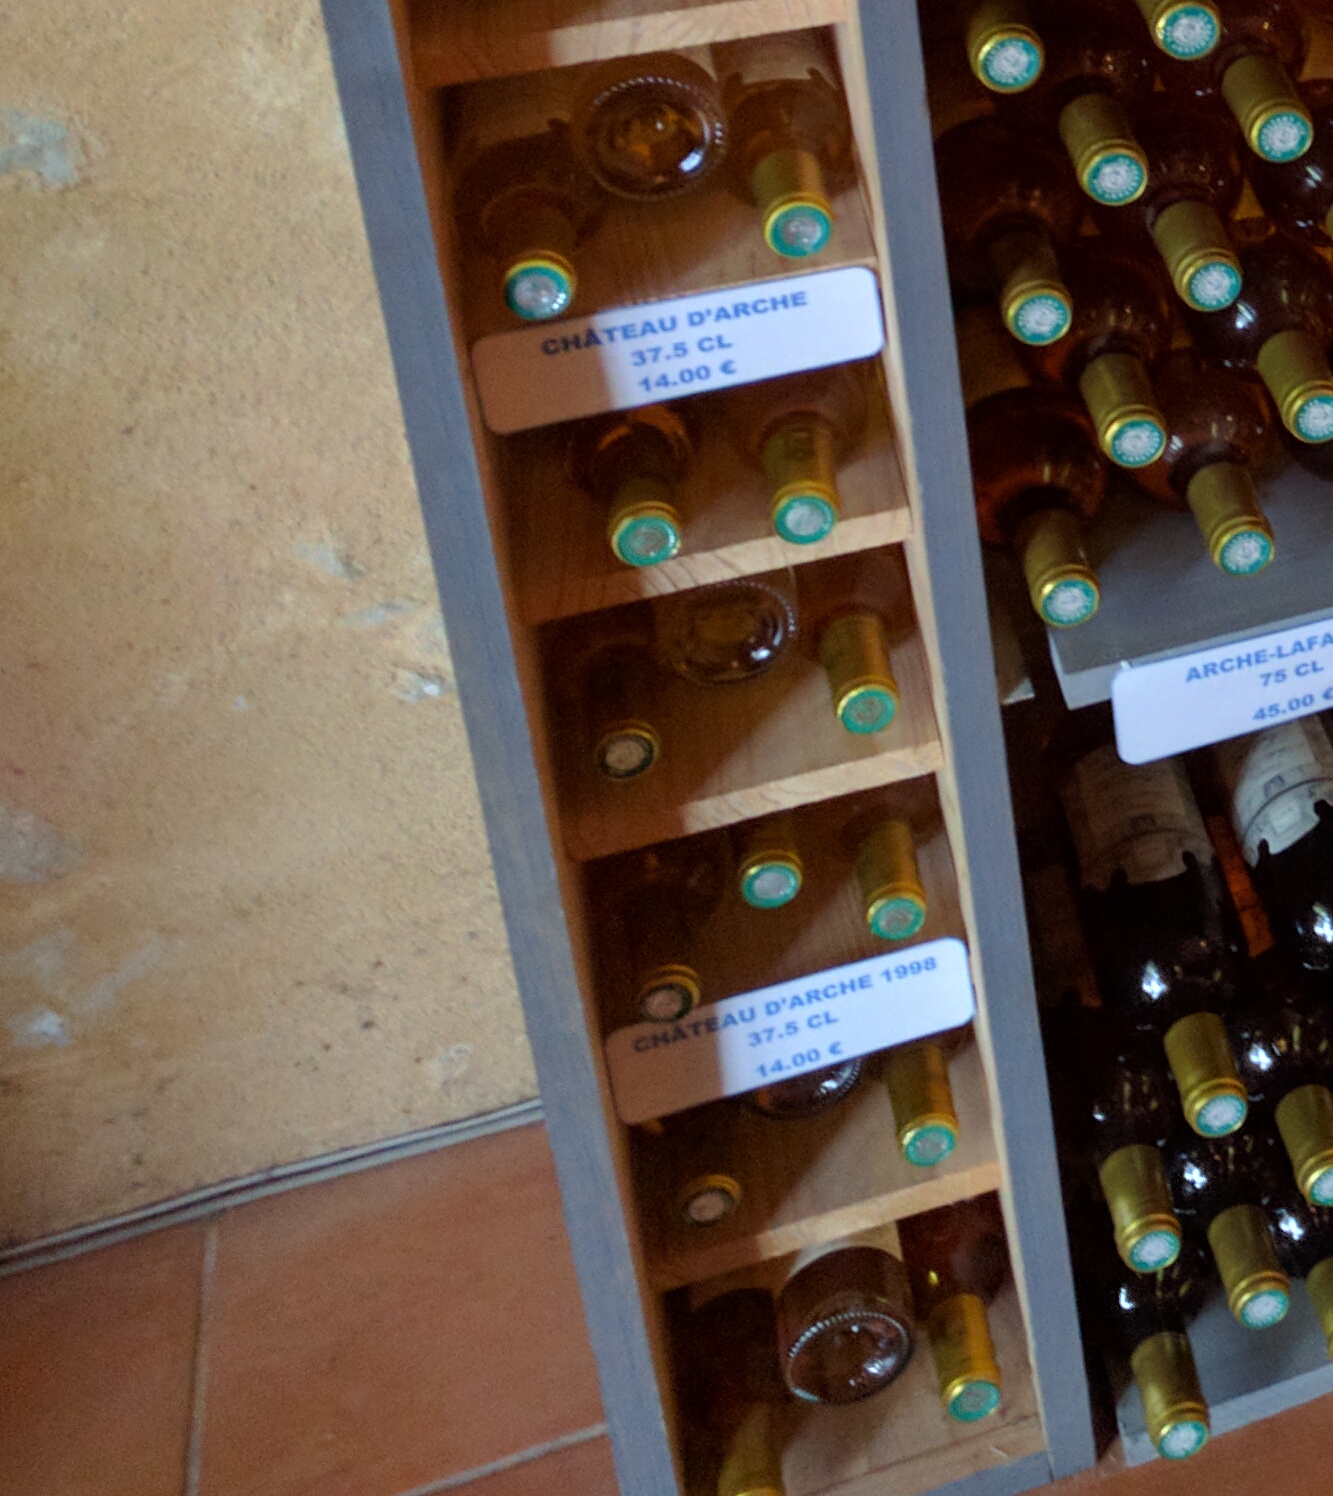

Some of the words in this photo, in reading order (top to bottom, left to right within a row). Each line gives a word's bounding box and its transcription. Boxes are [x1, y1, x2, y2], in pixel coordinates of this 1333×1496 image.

[541, 314, 678, 357] CHÂTEAU
[687, 290, 809, 328] D'ARCHE
[631, 340, 690, 369] 37.5
[696, 333, 734, 354] CL
[638, 364, 712, 394] 14.00
[719, 358, 738, 377] €
[1258, 668, 1289, 689] 75
[1294, 659, 1326, 679] CL
[1252, 692, 1316, 723] 45.00
[632, 1005, 757, 1054] CHÂTEAU
[763, 972, 875, 1018] D'ARCHE
[879, 956, 939, 985] 1998
[746, 1021, 800, 1049] 37.5
[805, 1008, 841, 1031] CL
[754, 1047, 822, 1079] 14.00
[827, 1040, 846, 1057] €
